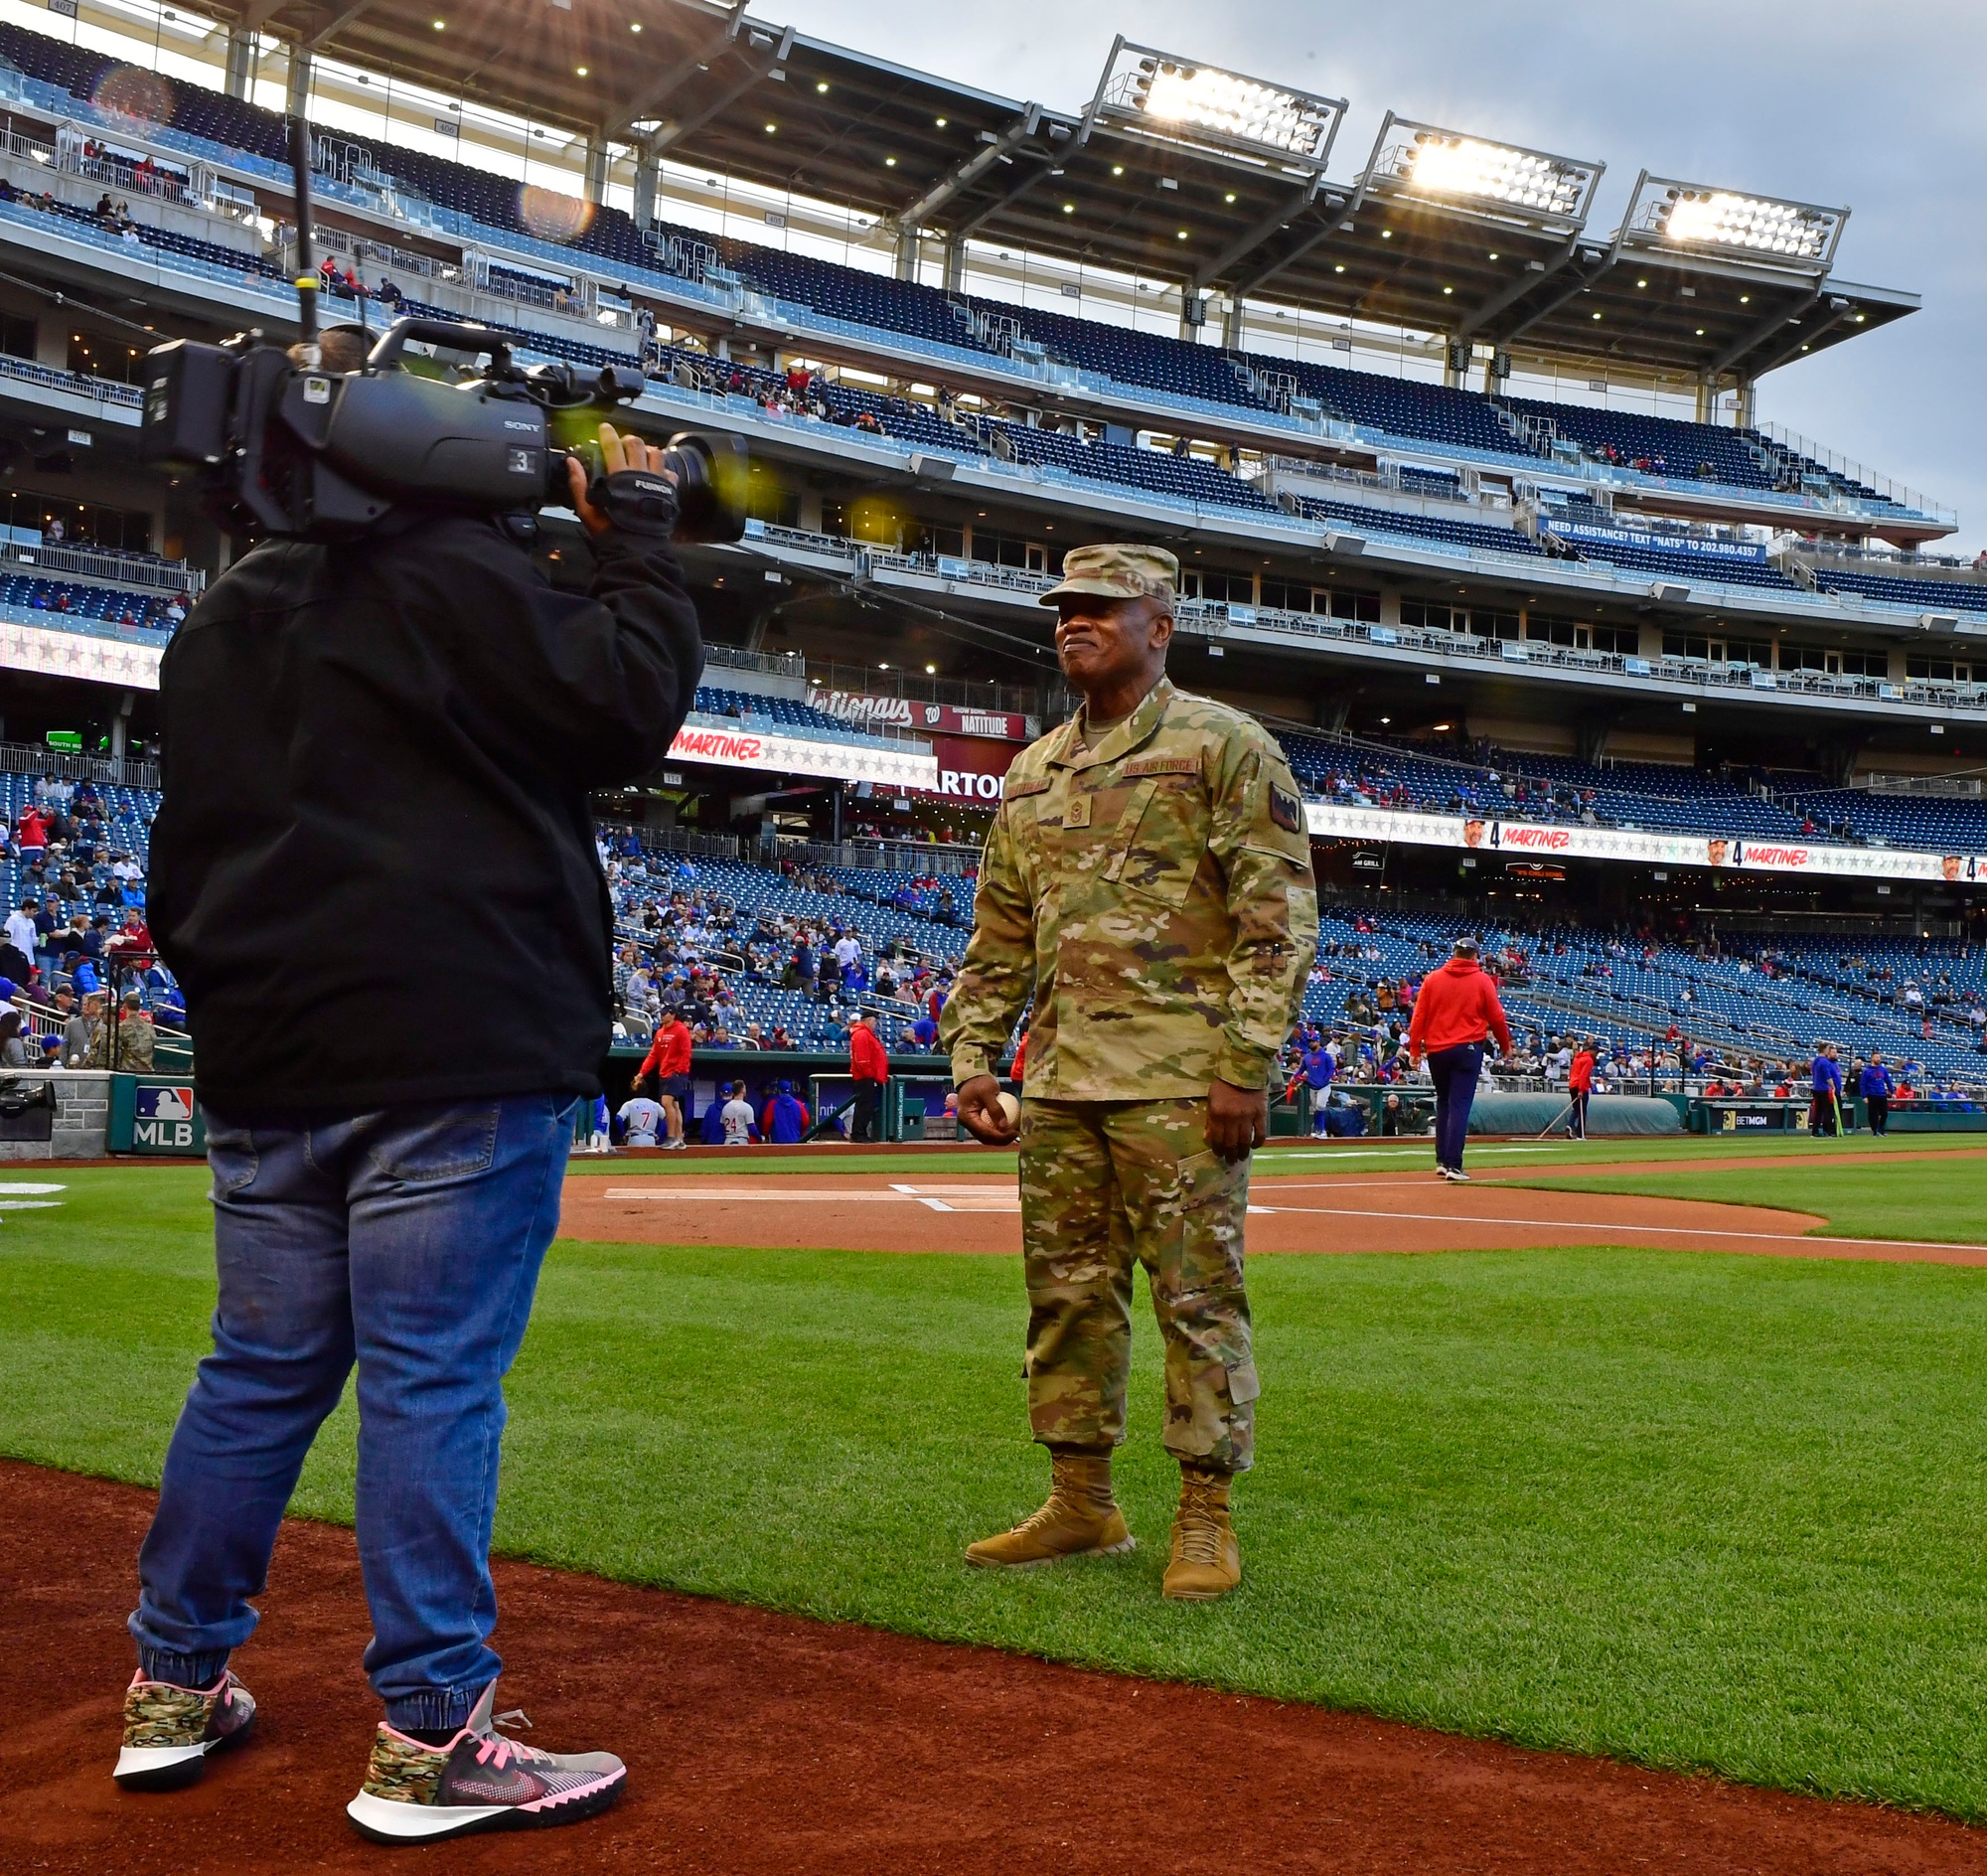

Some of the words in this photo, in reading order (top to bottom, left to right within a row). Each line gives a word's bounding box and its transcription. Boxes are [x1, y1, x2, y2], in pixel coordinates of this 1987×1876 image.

[55, 0, 72, 13] 407
[439, 123, 455, 135] 406
[504, 420, 540, 433] SONY
[517, 452, 528, 472] 3
[1548, 520, 1572, 535] NEED
[1573, 524, 1628, 542] ASSISTANCE?
[1630, 534, 1651, 546] TEXT
[1686, 540, 1699, 551] TO
[1700, 541, 1758, 557] 202.980.4357
[962, 715, 1008, 734] NATITUDE
[672, 730, 761, 761] MARTINEZ
[1126, 763, 1140, 774] US
[1143, 761, 1158, 773] AIR
[1160, 759, 1193, 772] FORCE
[1490, 822, 1500, 849] 4
[1502, 828, 1570, 850] MARTINEZ
[1733, 842, 1742, 866] 4
[1744, 847, 1808, 867] MARTINEZ
[1966, 857, 1975, 881] 4
[641, 1112, 651, 1129] 7
[724, 1117, 737, 1133] 24
[1736, 1115, 1767, 1126] BETMGM
[133, 1122, 193, 1147] MLB
